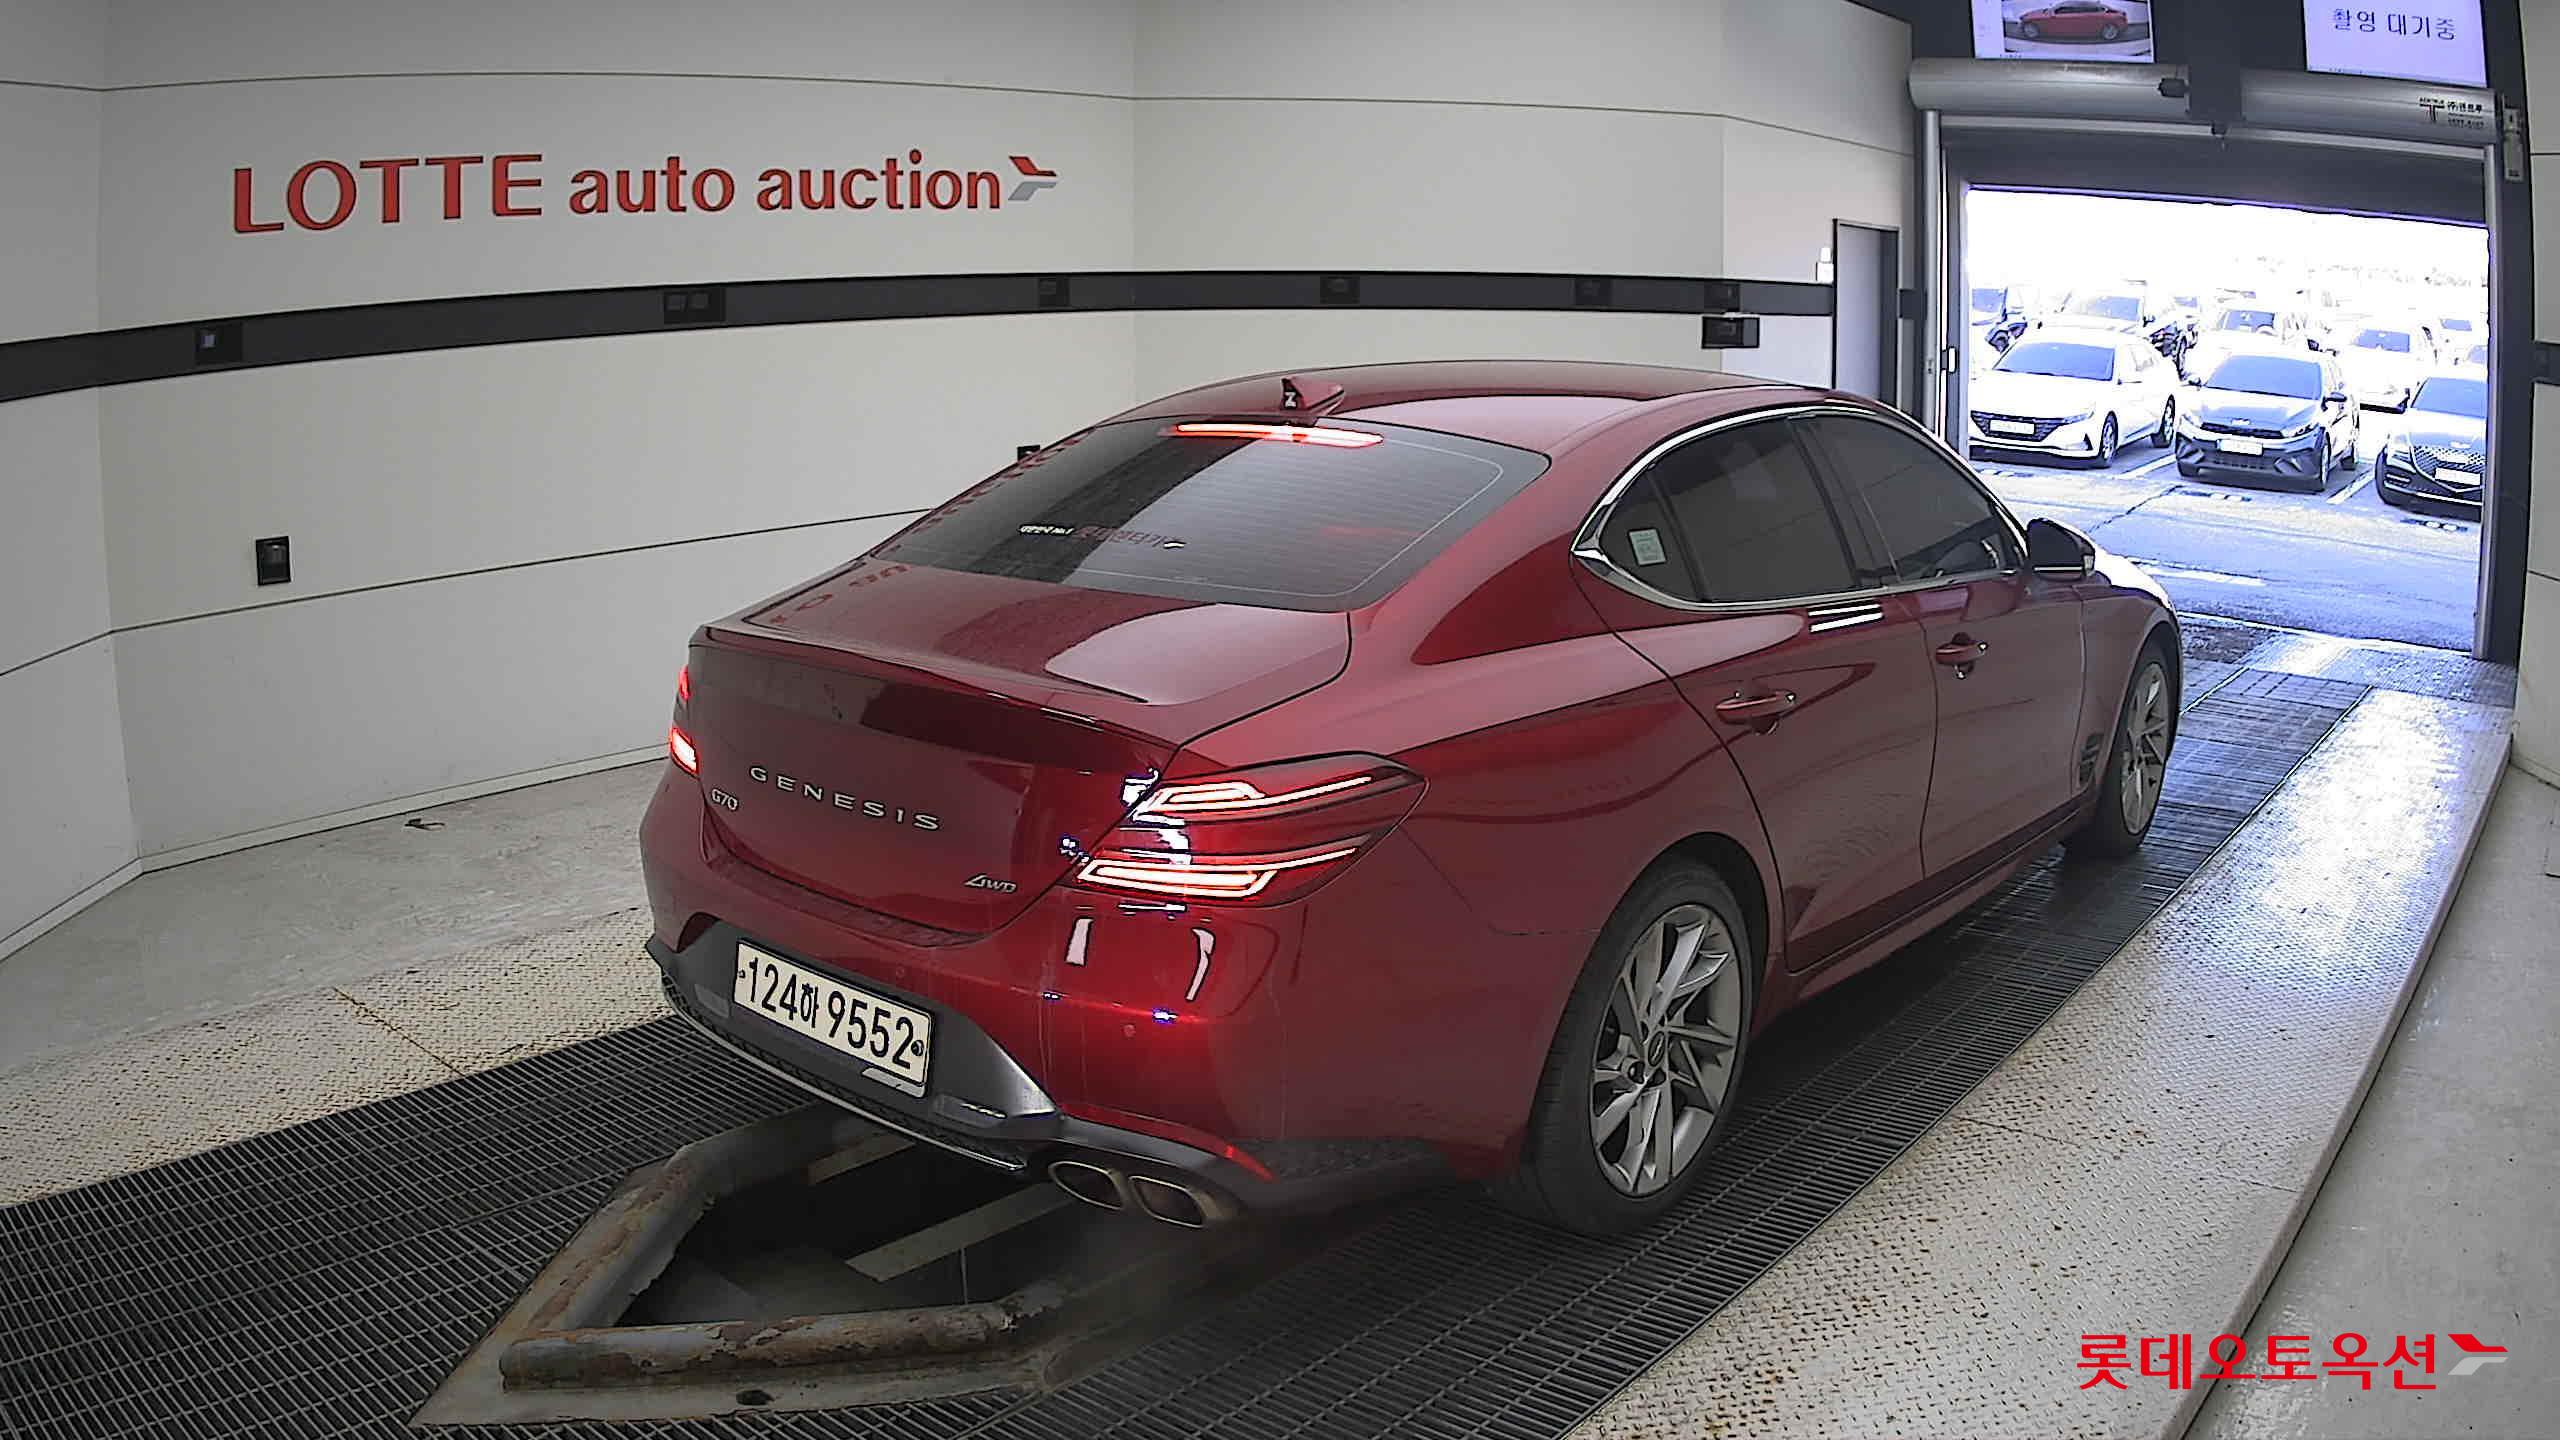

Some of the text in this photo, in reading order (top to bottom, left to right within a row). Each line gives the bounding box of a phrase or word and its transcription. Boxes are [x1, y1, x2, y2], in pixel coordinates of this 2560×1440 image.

[2387, 13, 2455, 41] 대기중
[233, 148, 1002, 233] LOTTE auto auction
[711, 787, 739, 812] G70
[750, 766, 940, 831] GENESIS
[963, 874, 1017, 894] 4WD
[748, 956, 915, 1070] 124하 9552
